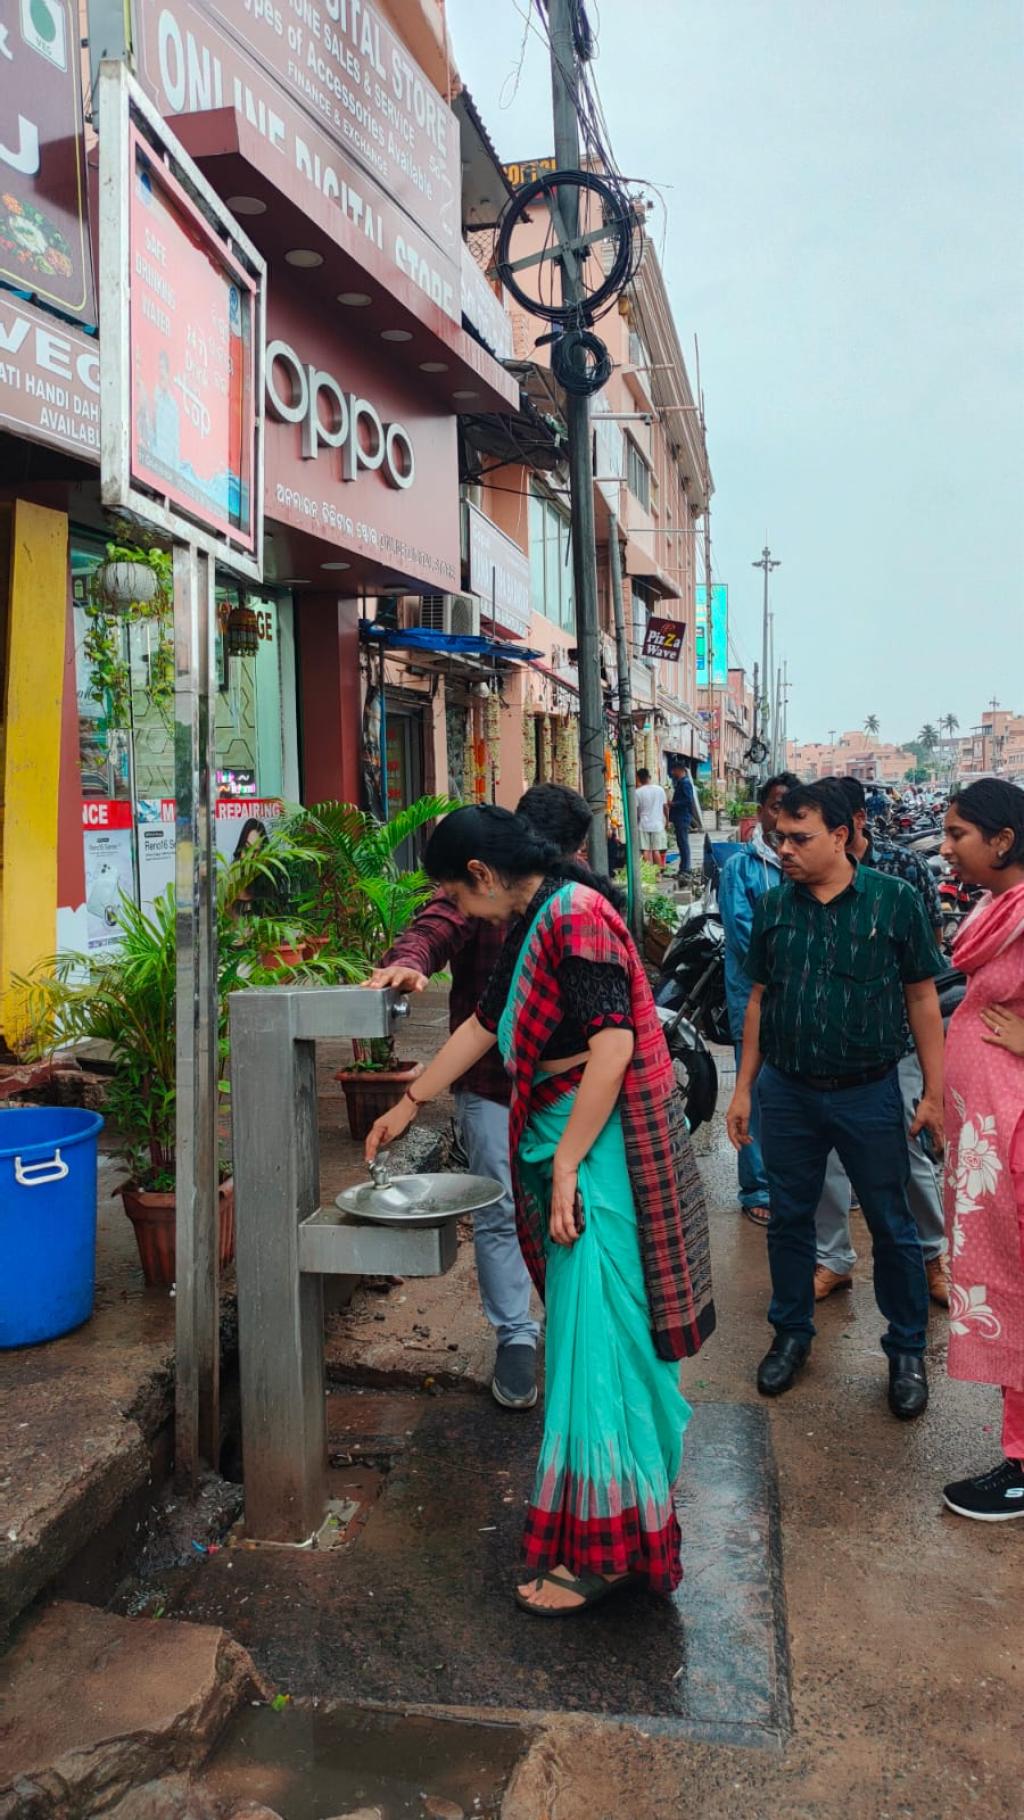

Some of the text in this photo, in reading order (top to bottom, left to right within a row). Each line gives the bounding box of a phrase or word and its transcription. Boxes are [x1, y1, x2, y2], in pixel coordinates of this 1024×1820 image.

[287, 25, 303, 56] of
[306, 41, 386, 148] Accessories
[387, 130, 433, 201] Available
[287, 60, 332, 117] FINANCE
[343, 118, 389, 176] EXCHANGE
[323, 23, 361, 85] SALES
[374, 82, 415, 150] SERVICE
[391, 46, 447, 159] STORE
[25, 372, 70, 410] HANDI
[265, 339, 416, 489] oppo
[646, 645, 678, 660] Wave
[218, 802, 281, 819] REPAIRING
